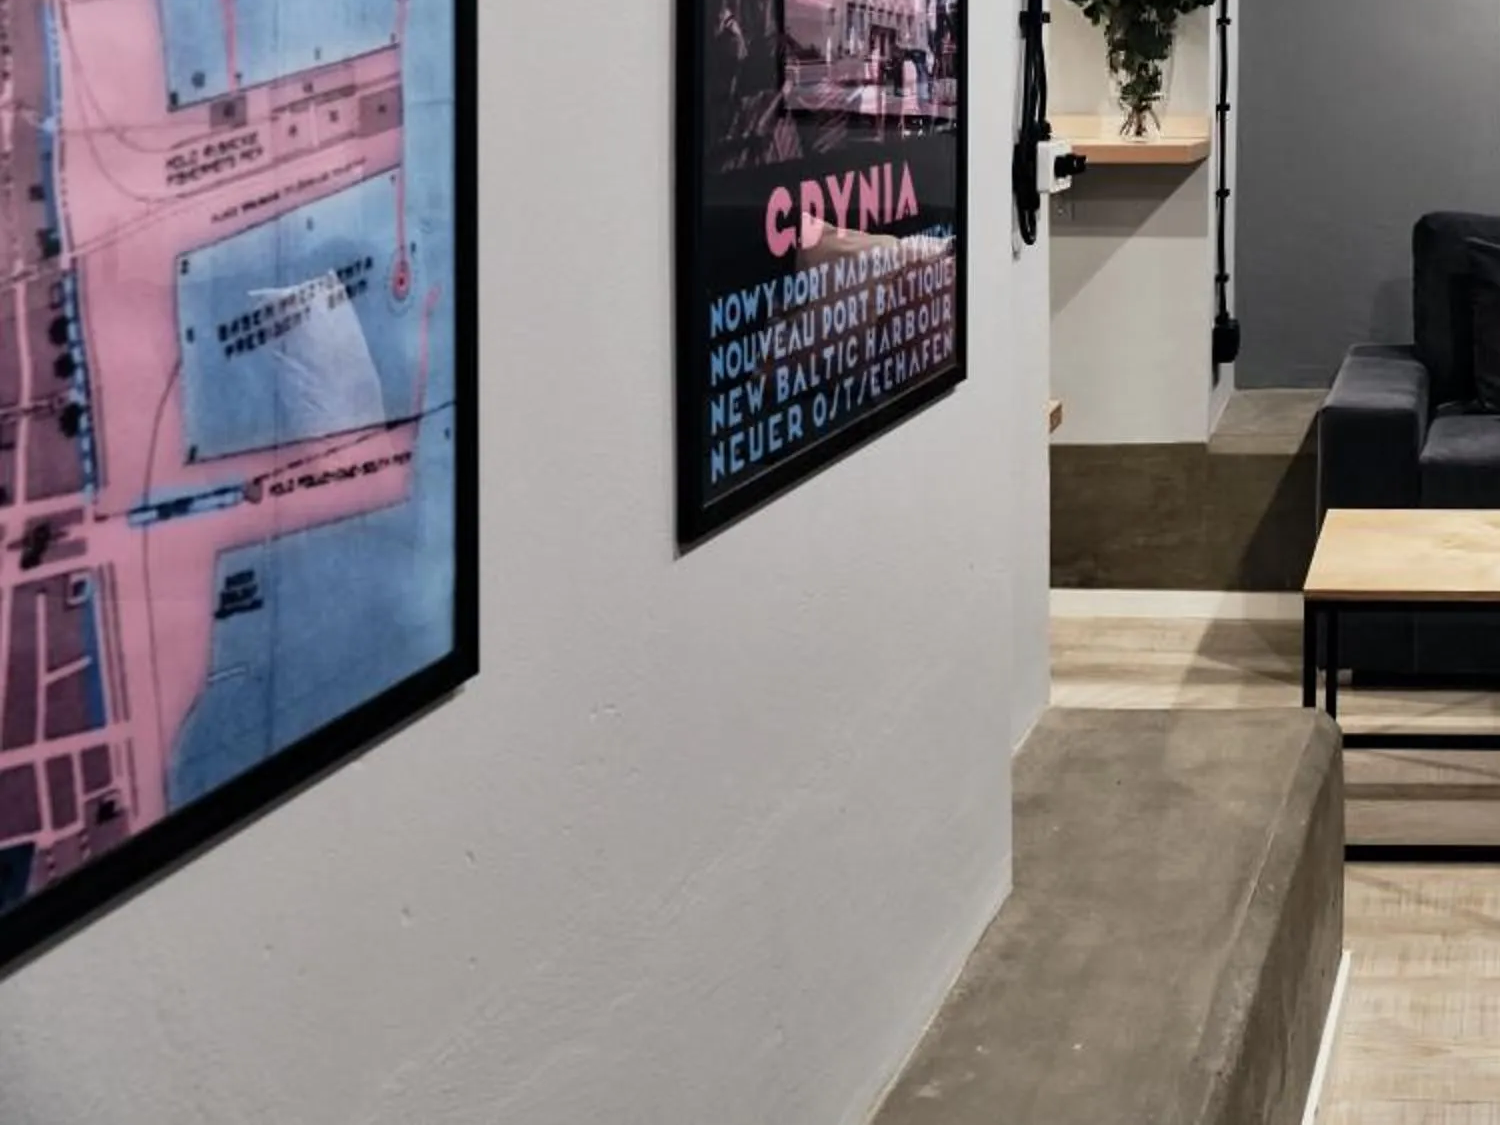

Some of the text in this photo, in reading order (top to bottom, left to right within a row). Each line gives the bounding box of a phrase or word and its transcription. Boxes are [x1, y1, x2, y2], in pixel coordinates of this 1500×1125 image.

[764, 161, 919, 257] GDYNIA
[709, 278, 778, 339] NOWY
[783, 261, 830, 312] PORT
[834, 249, 868, 294] NAD
[709, 255, 955, 387] NOUVEAU PORT BALTIQUE
[709, 293, 952, 435] NEW BALTIC HARBOUR
[709, 404, 804, 485] NEUER
